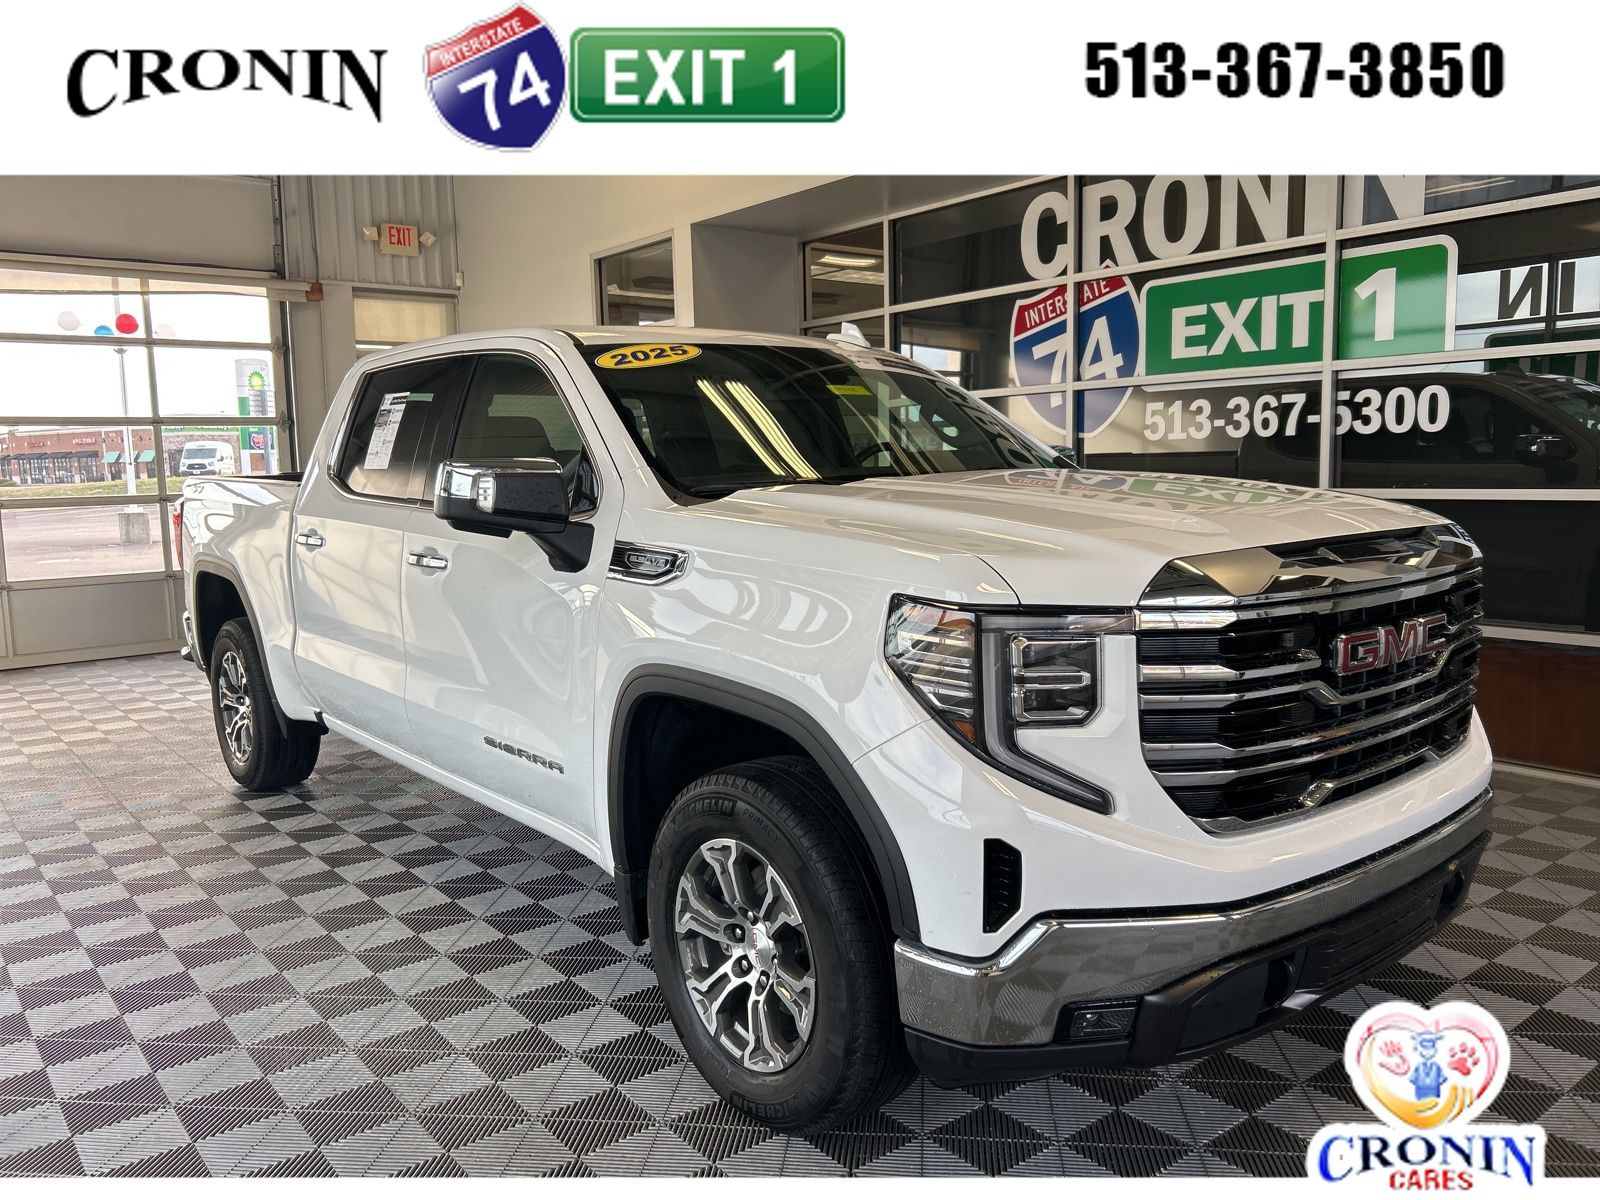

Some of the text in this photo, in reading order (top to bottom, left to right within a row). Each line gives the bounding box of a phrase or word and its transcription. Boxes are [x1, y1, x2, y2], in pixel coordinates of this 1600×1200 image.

[388, 225, 412, 247] EXIT
[1024, 279, 1110, 329] INTERATE
[1171, 267, 1397, 359] EXIT 1
[610, 345, 690, 367] 2025
[1032, 315, 1124, 409] 74
[1143, 385, 1450, 441] 513-367-5300
[1335, 613, 1447, 676] GMC
[483, 735, 565, 775] SIERRA
[675, 798, 782, 842] MICHELIN PRIMACY
